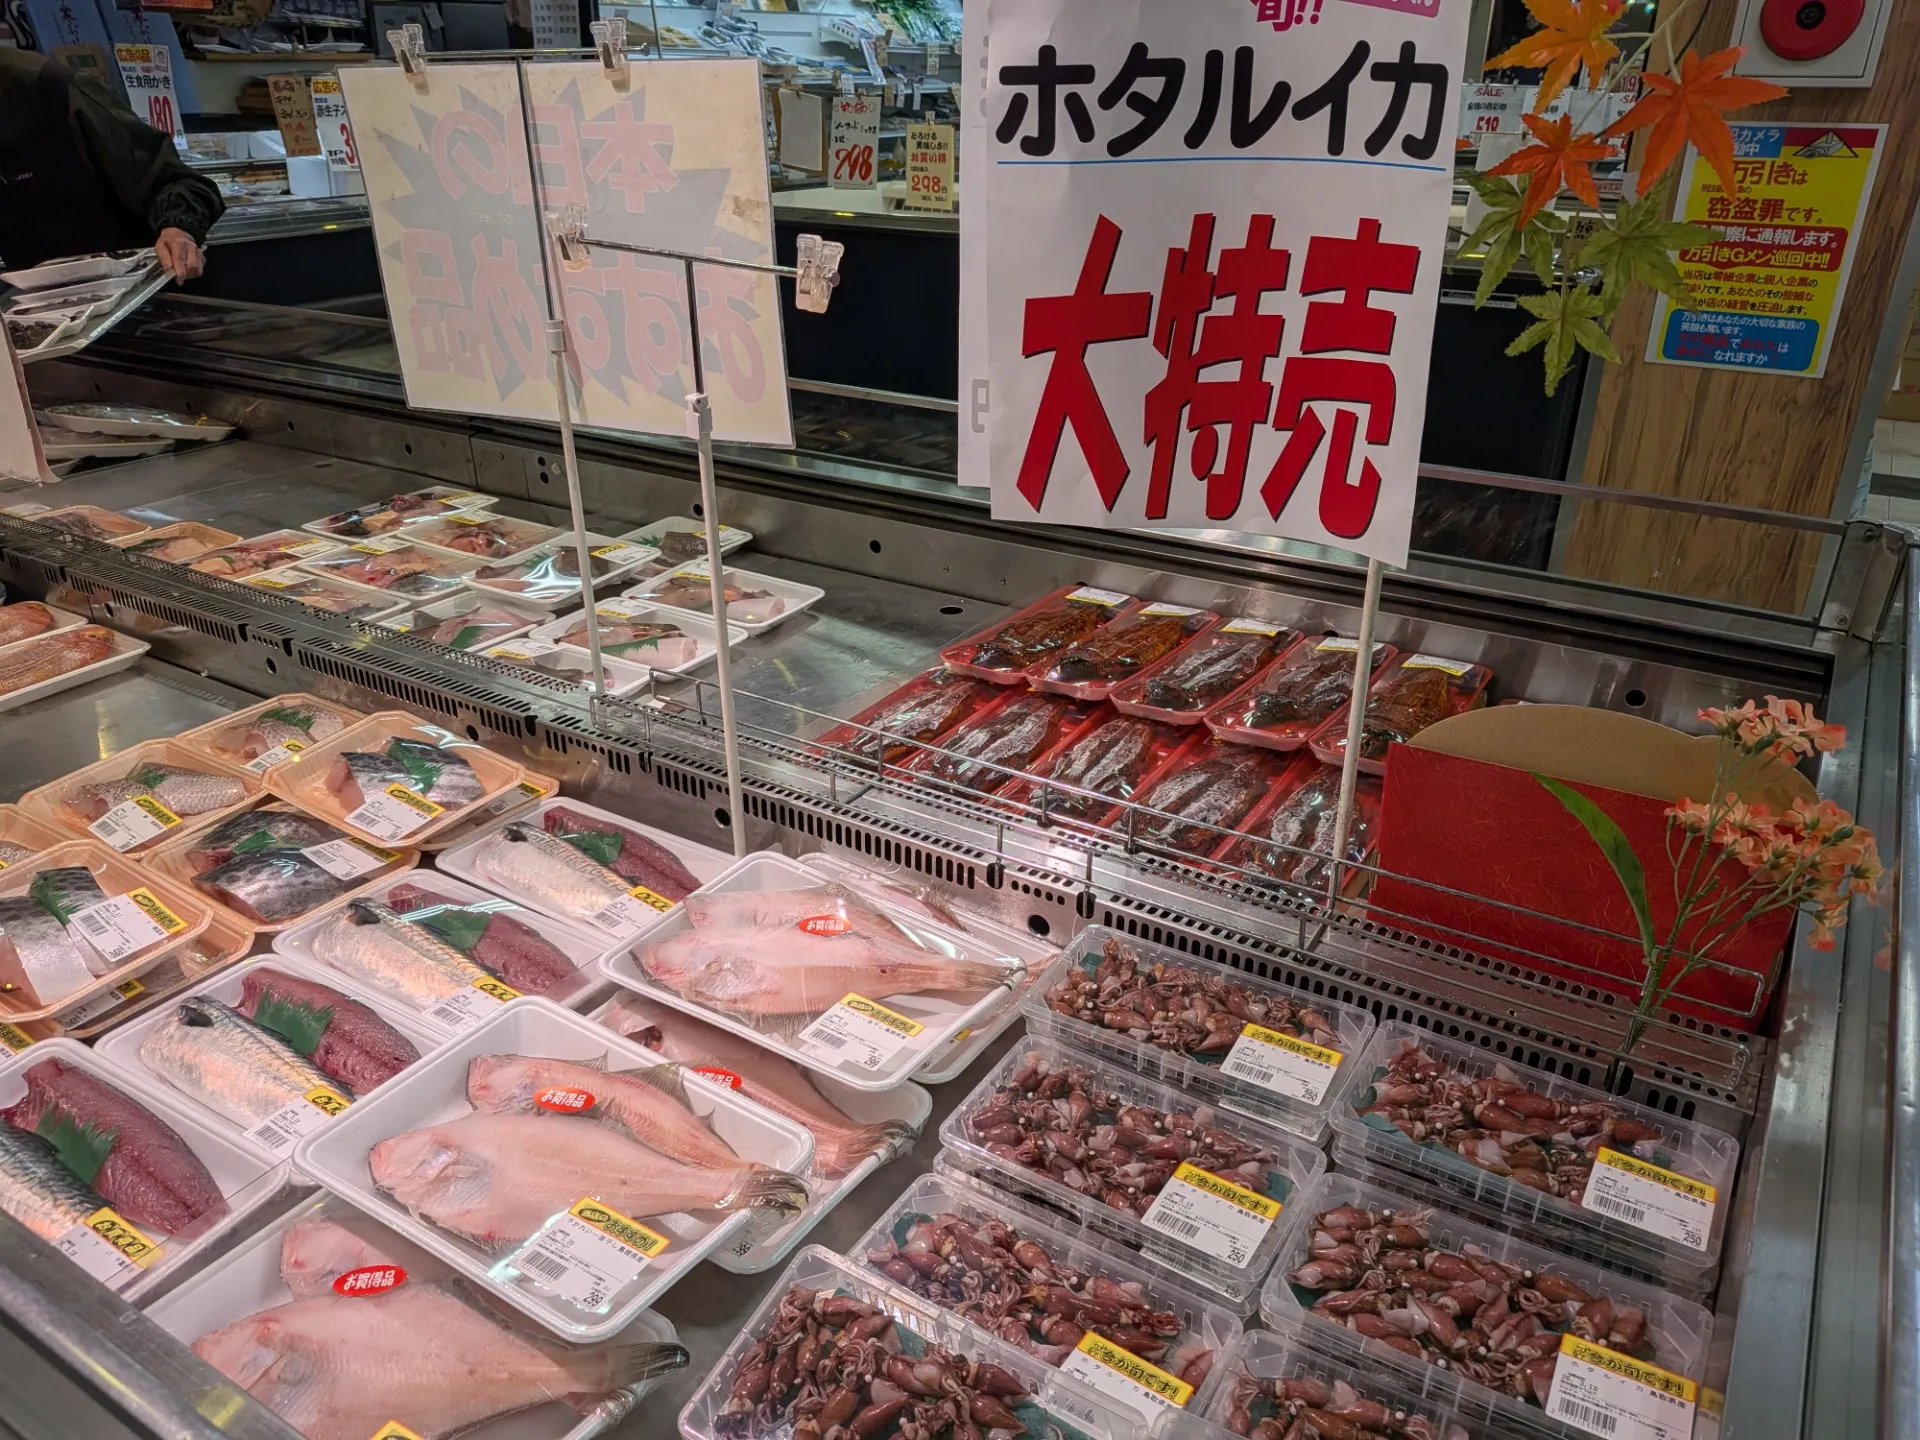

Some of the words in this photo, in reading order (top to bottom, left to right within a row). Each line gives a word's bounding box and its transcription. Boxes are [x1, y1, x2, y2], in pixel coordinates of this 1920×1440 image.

[125, 74, 171, 89] 生食用かき
[995, 40, 1449, 159] ホタルイカ
[1476, 87, 1504, 97] SALE
[910, 131, 937, 141] とろける
[1016, 212, 1422, 540] 大特売
[541, 1088, 588, 1108] お買得品
[1302, 1089, 1318, 1102] 250
[1683, 1232, 1702, 1246] 250
[1227, 1249, 1246, 1264] 250
[343, 1269, 396, 1291] お買得品
[583, 1291, 604, 1307] 299
